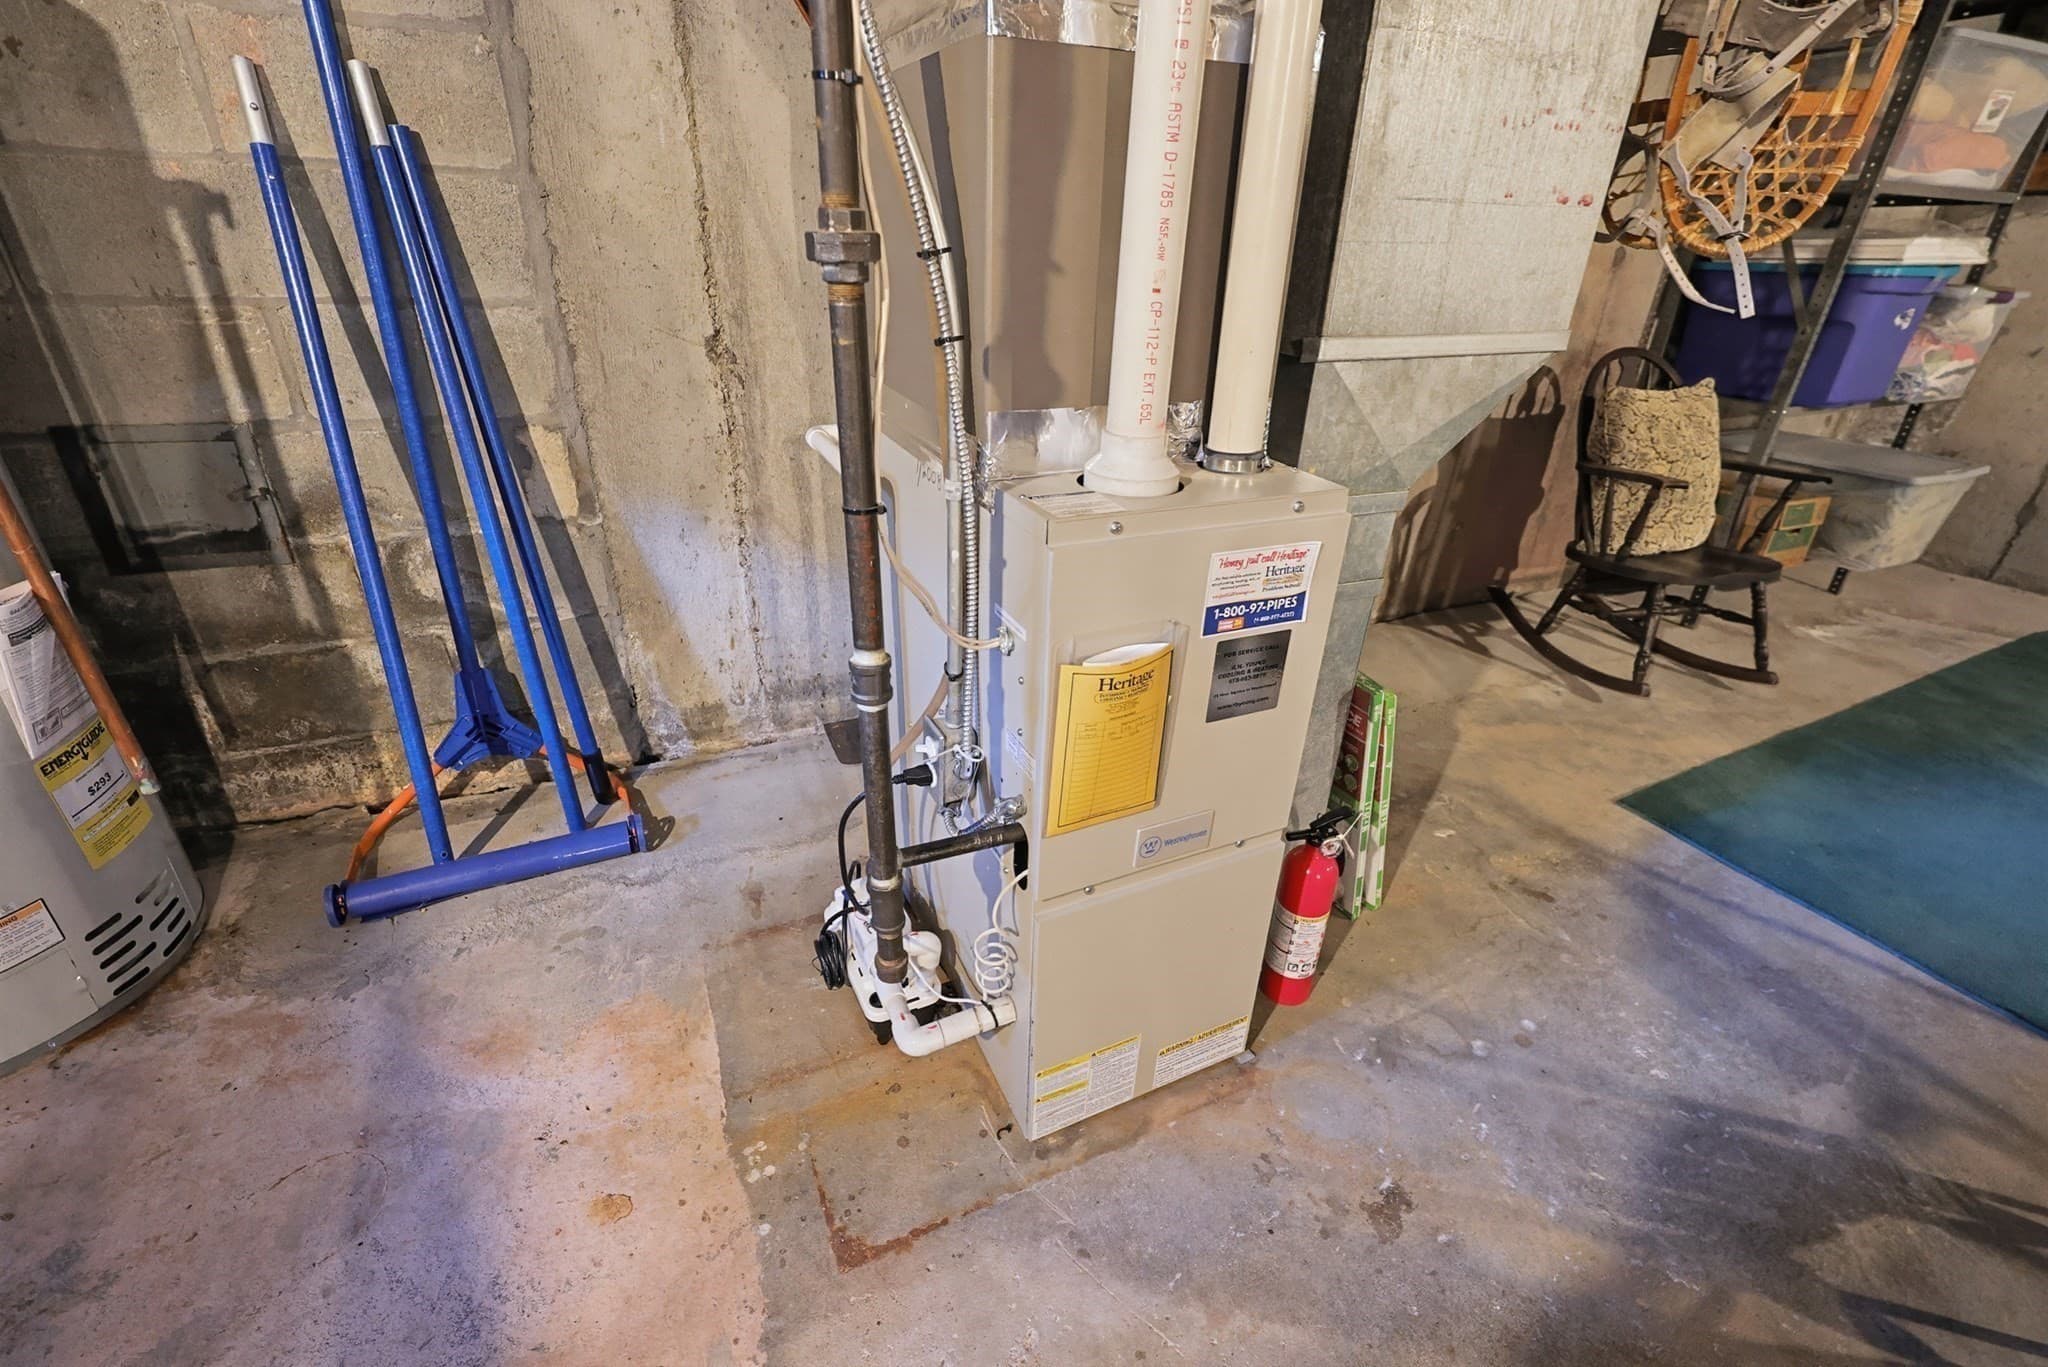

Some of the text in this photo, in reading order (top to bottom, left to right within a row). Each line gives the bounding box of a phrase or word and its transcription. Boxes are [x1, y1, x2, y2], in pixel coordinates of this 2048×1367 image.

[1166, 102, 1183, 143] ASTM
[1160, 151, 1178, 208] D-1785
[1146, 301, 1163, 366] CP-112-P
[1213, 596, 1298, 620] 1-800-97-PIPES
[1098, 668, 1155, 692] Heritage
[87, 771, 112, 797] $293
